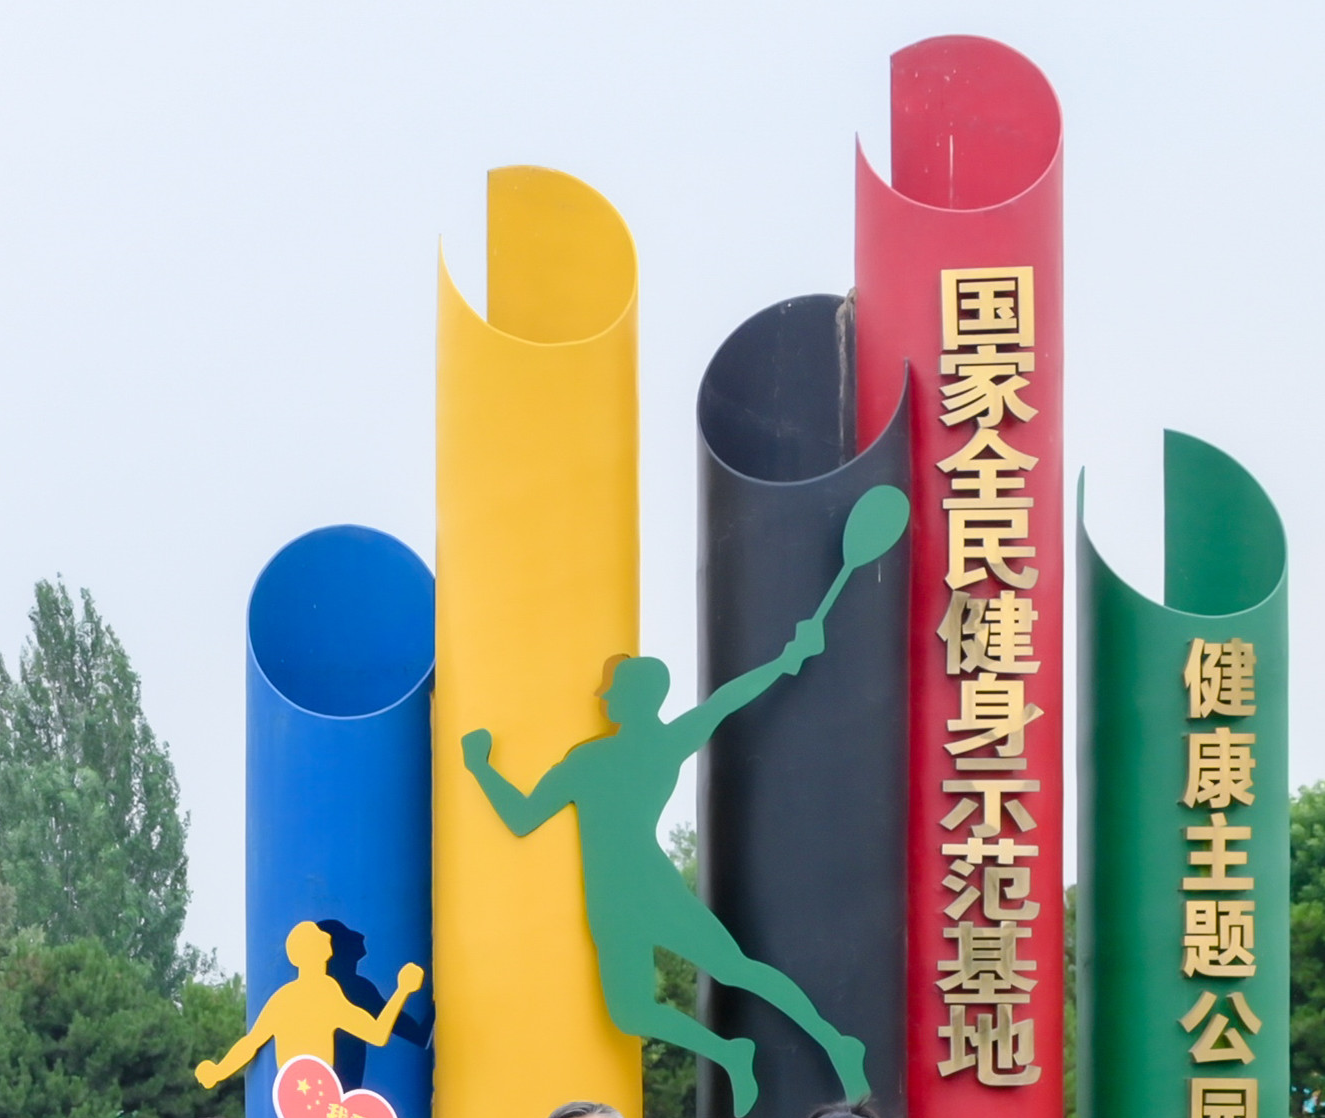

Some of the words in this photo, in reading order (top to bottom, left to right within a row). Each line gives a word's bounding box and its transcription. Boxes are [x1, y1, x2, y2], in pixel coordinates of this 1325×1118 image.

[935, 266, 1044, 1087] 国家全民健身示范基地
